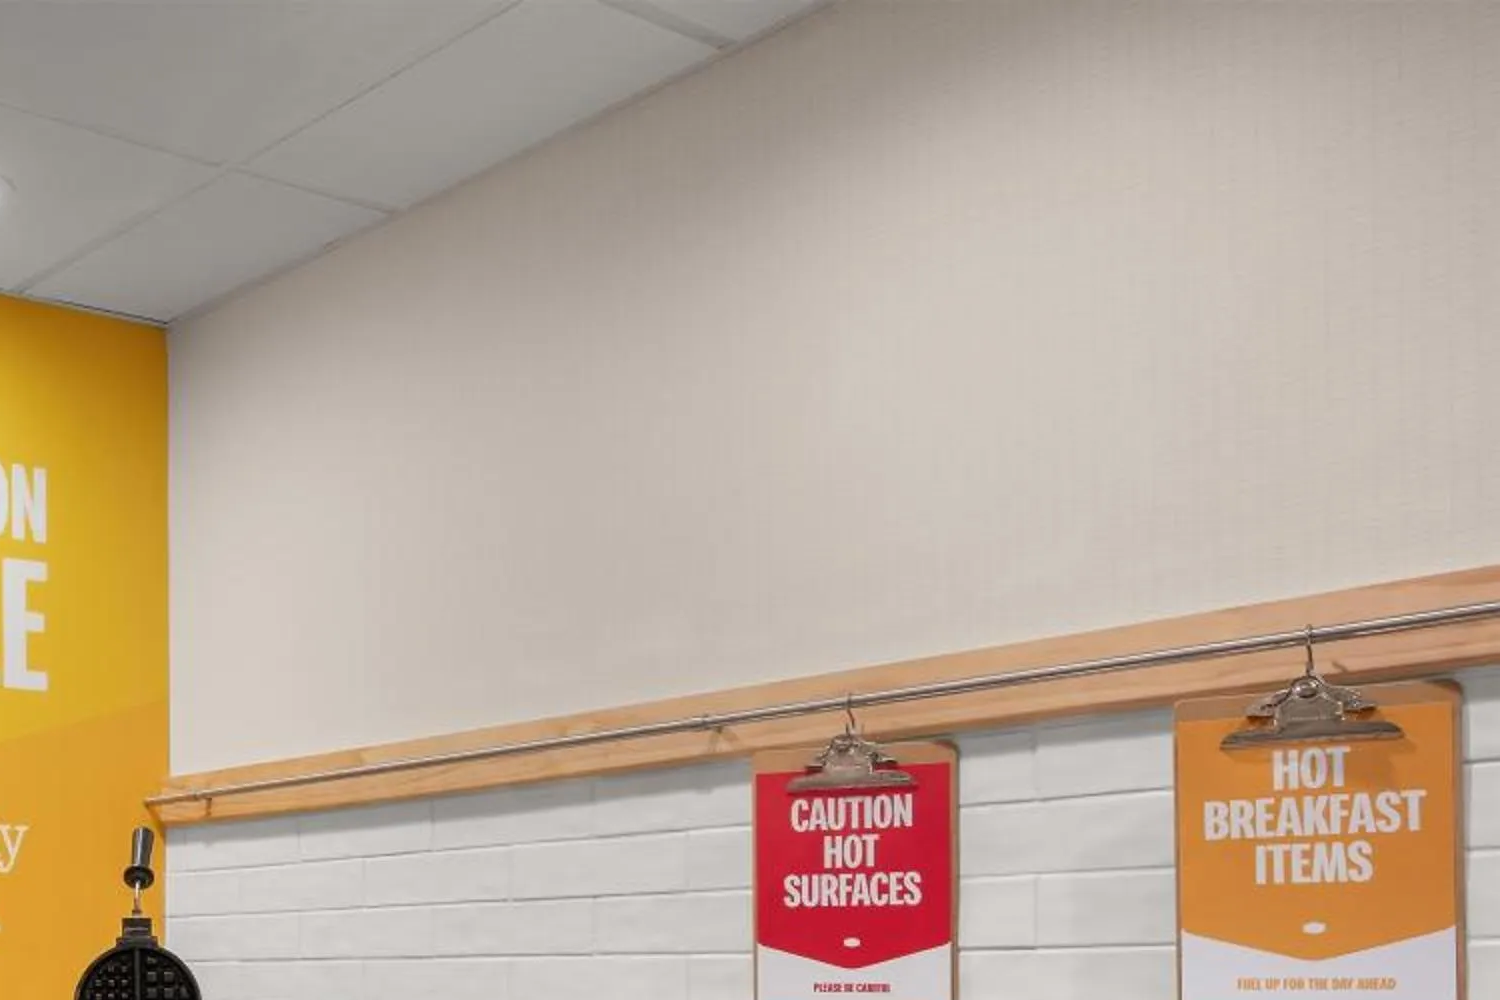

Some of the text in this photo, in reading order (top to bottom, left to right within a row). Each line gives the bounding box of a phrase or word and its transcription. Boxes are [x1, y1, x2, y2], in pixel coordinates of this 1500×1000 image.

[1272, 746, 1351, 791] HOT
[790, 793, 914, 832] CAUTION
[1203, 789, 1427, 841] BREAKFAST
[823, 834, 880, 869] HOT
[1254, 840, 1374, 885] ITEMS
[783, 871, 923, 908] SURFACES
